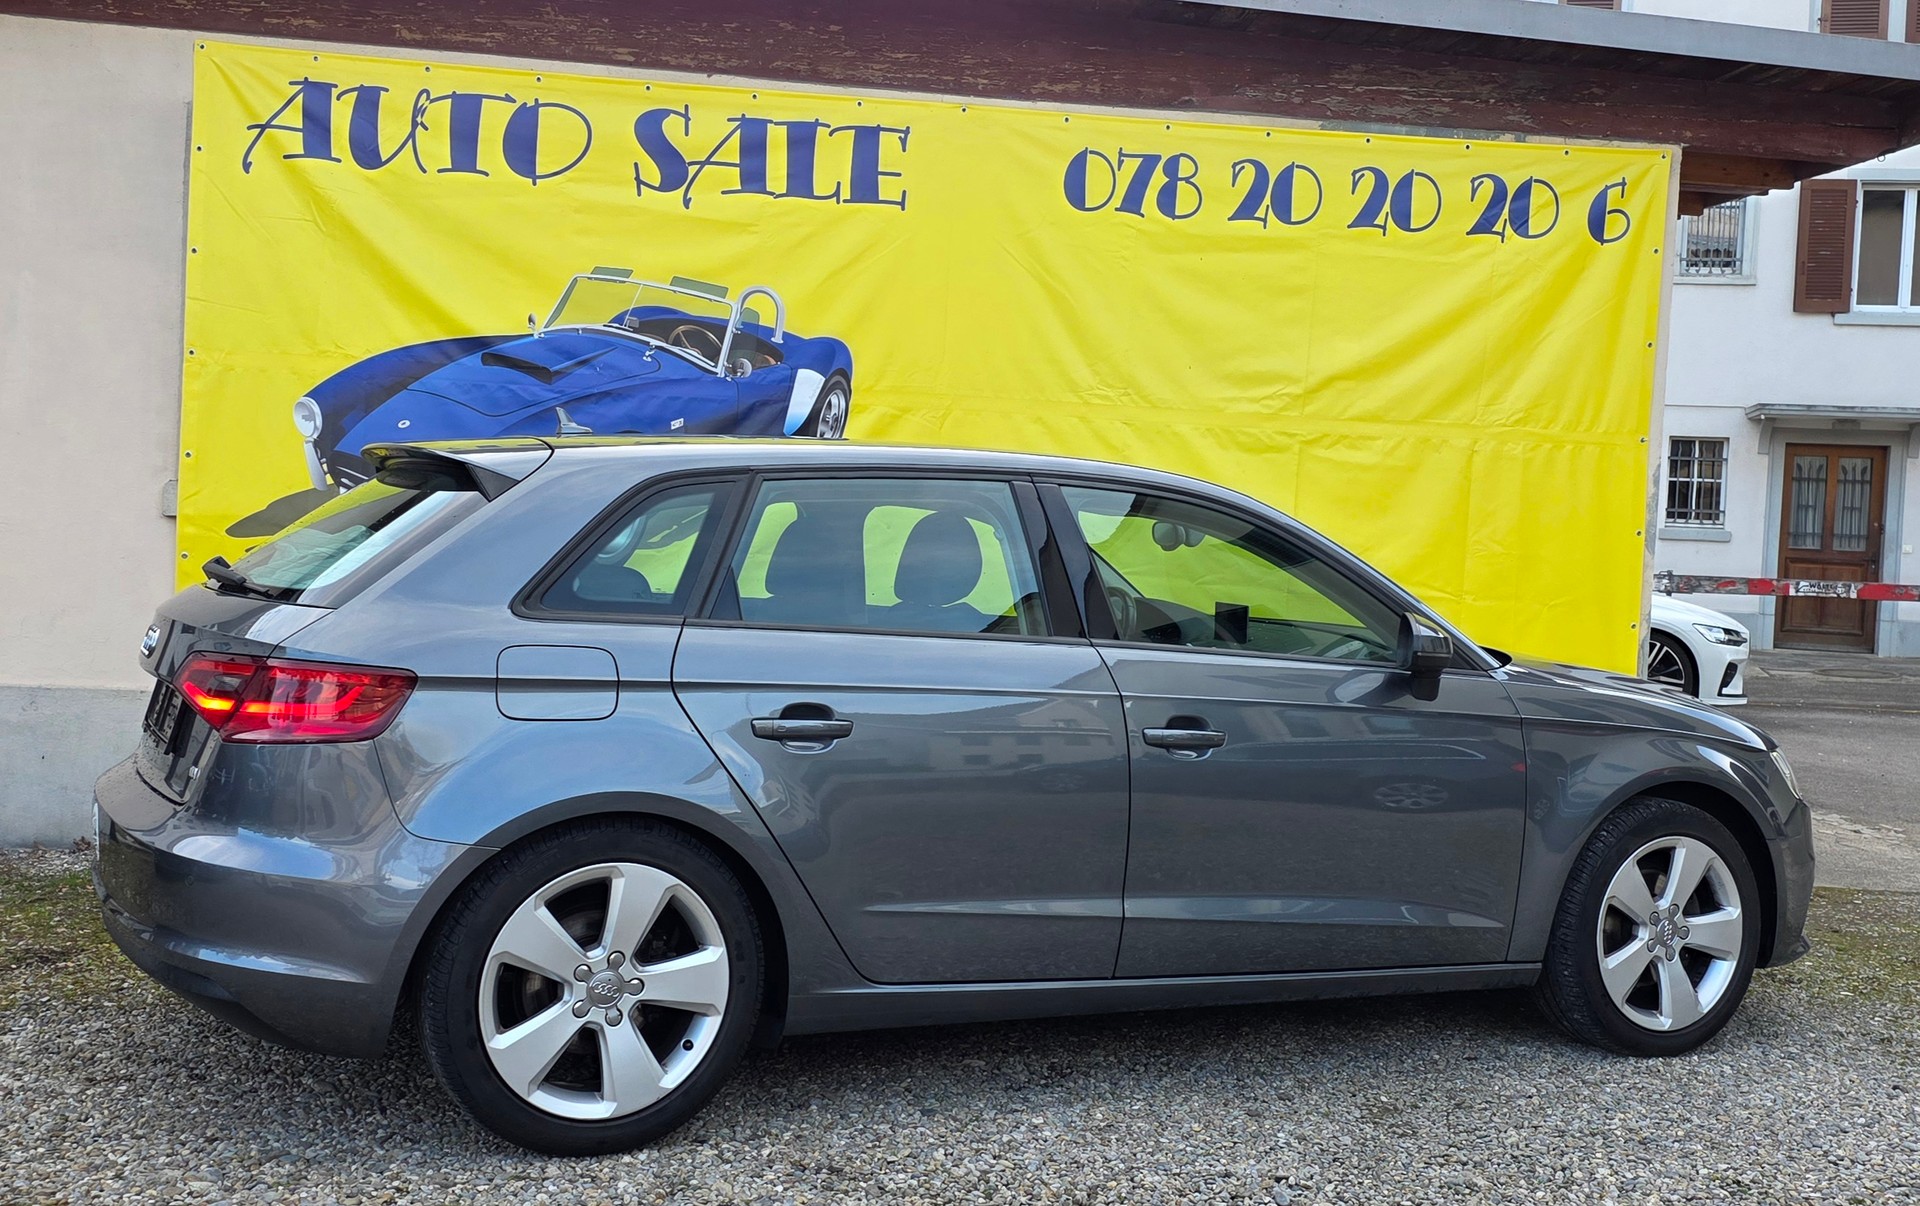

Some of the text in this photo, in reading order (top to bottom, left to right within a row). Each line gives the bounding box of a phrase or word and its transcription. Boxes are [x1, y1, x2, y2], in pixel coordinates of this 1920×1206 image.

[242, 77, 911, 211] AUTO SALE
[1063, 147, 1631, 244] 078 20 20 20 6
